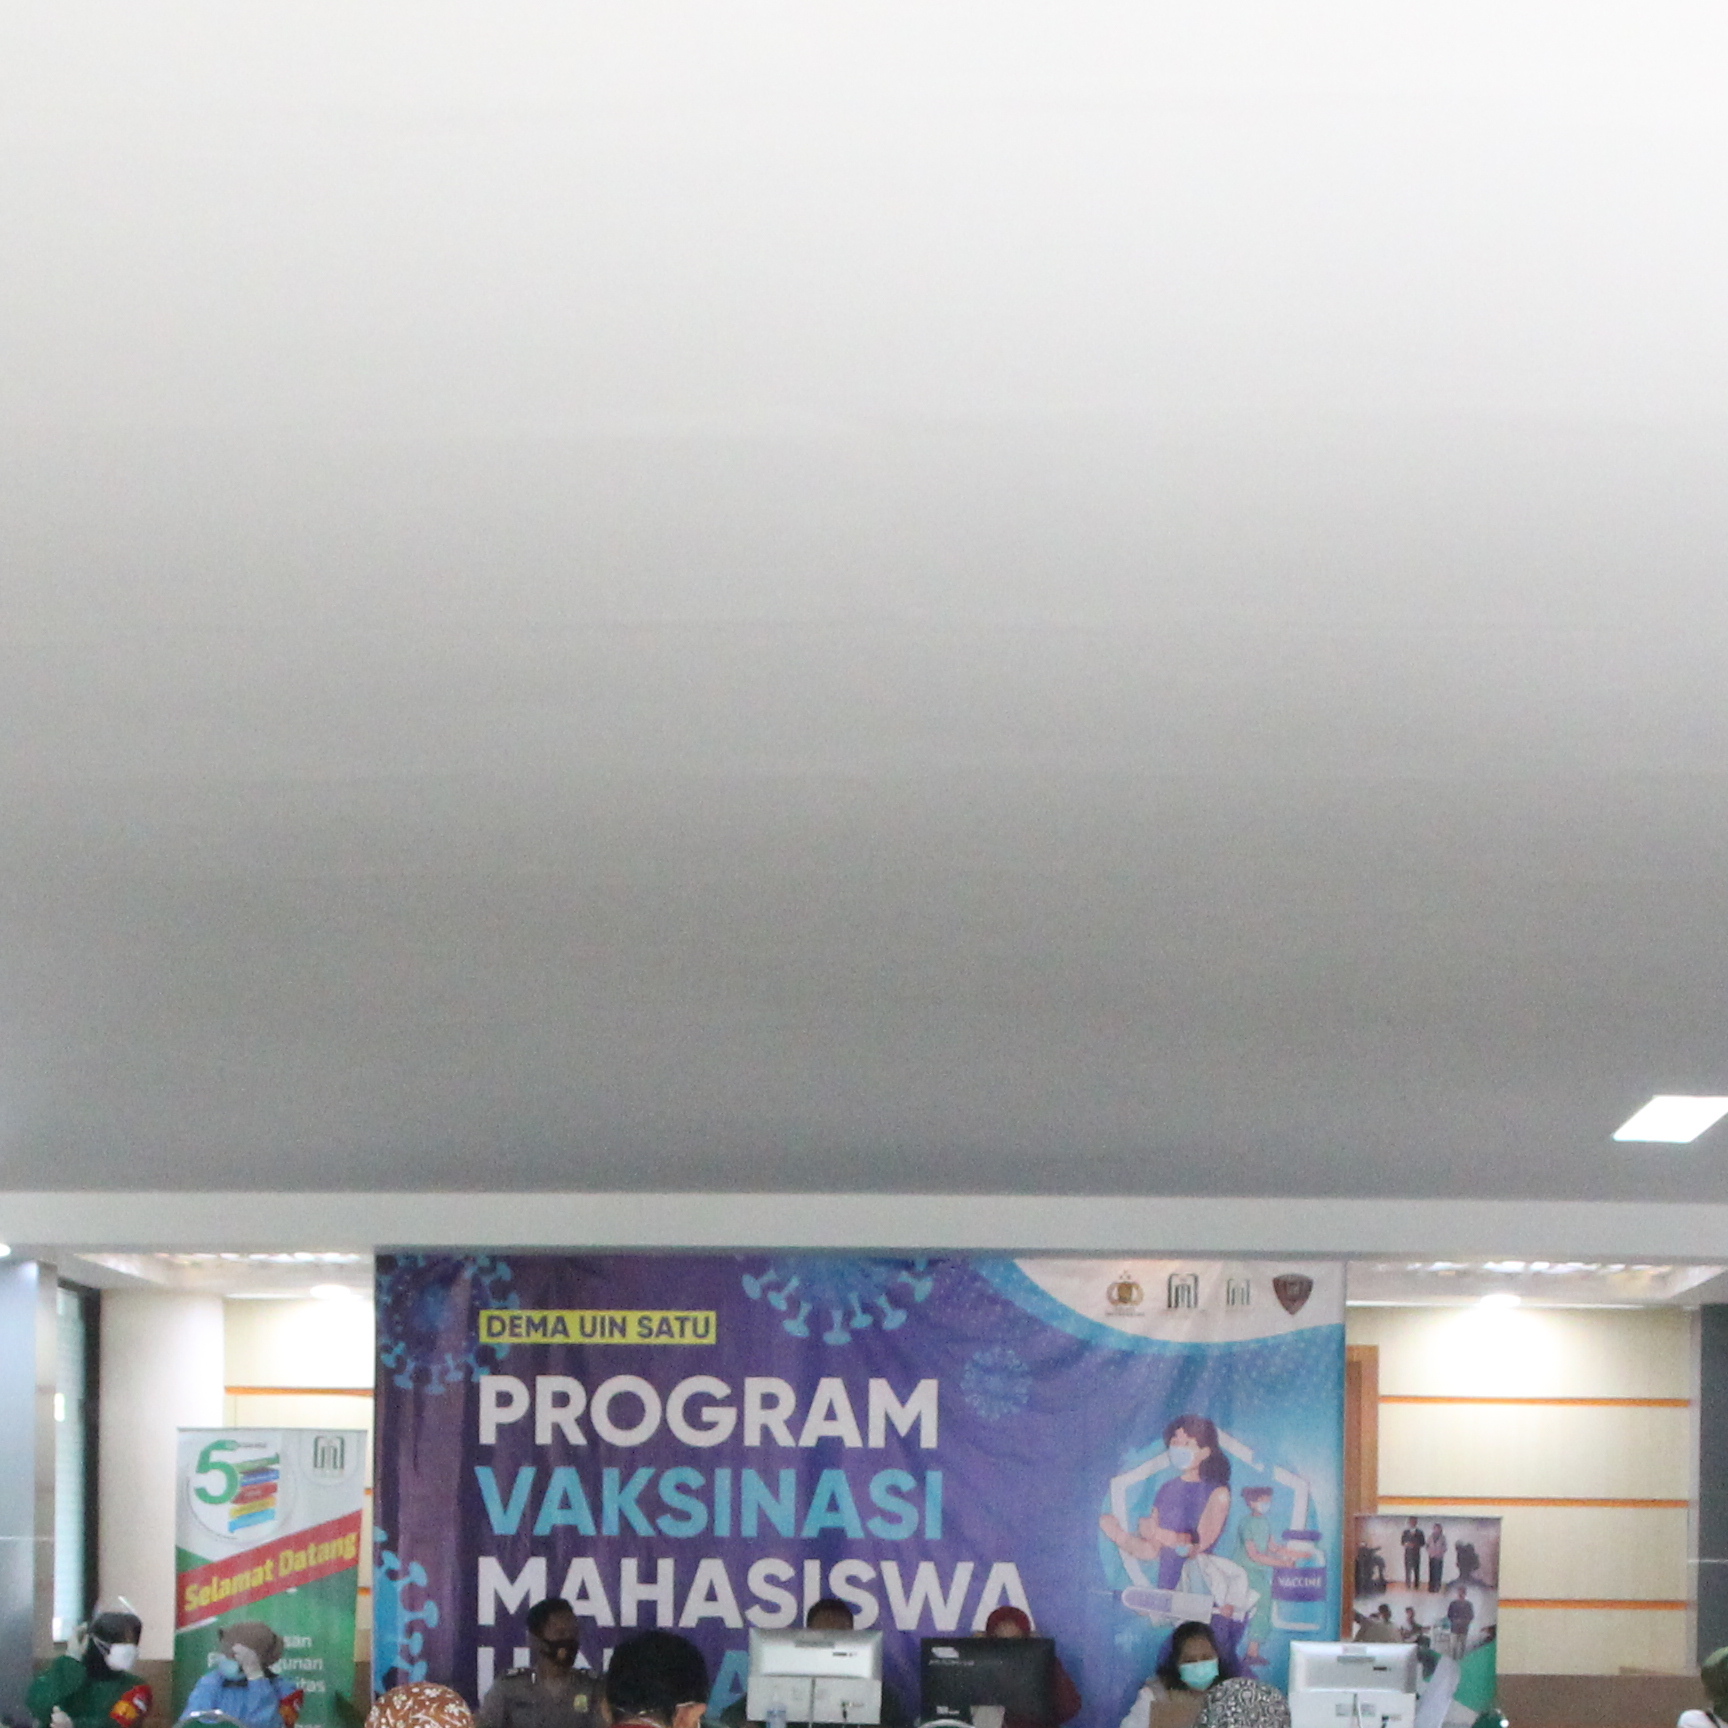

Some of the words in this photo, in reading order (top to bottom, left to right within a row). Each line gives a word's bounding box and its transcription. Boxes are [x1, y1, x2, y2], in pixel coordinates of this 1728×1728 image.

[486, 1315, 570, 1339] DEMA
[579, 1315, 627, 1339] UIN
[637, 1316, 710, 1339] SATU
[478, 1374, 939, 1449] PROGRAM
[475, 1464, 942, 1540] VAKSINASI
[184, 1559, 275, 1612] Selamat
[279, 1533, 359, 1578] Datang
[478, 1556, 1032, 1633] MAHASISWA
